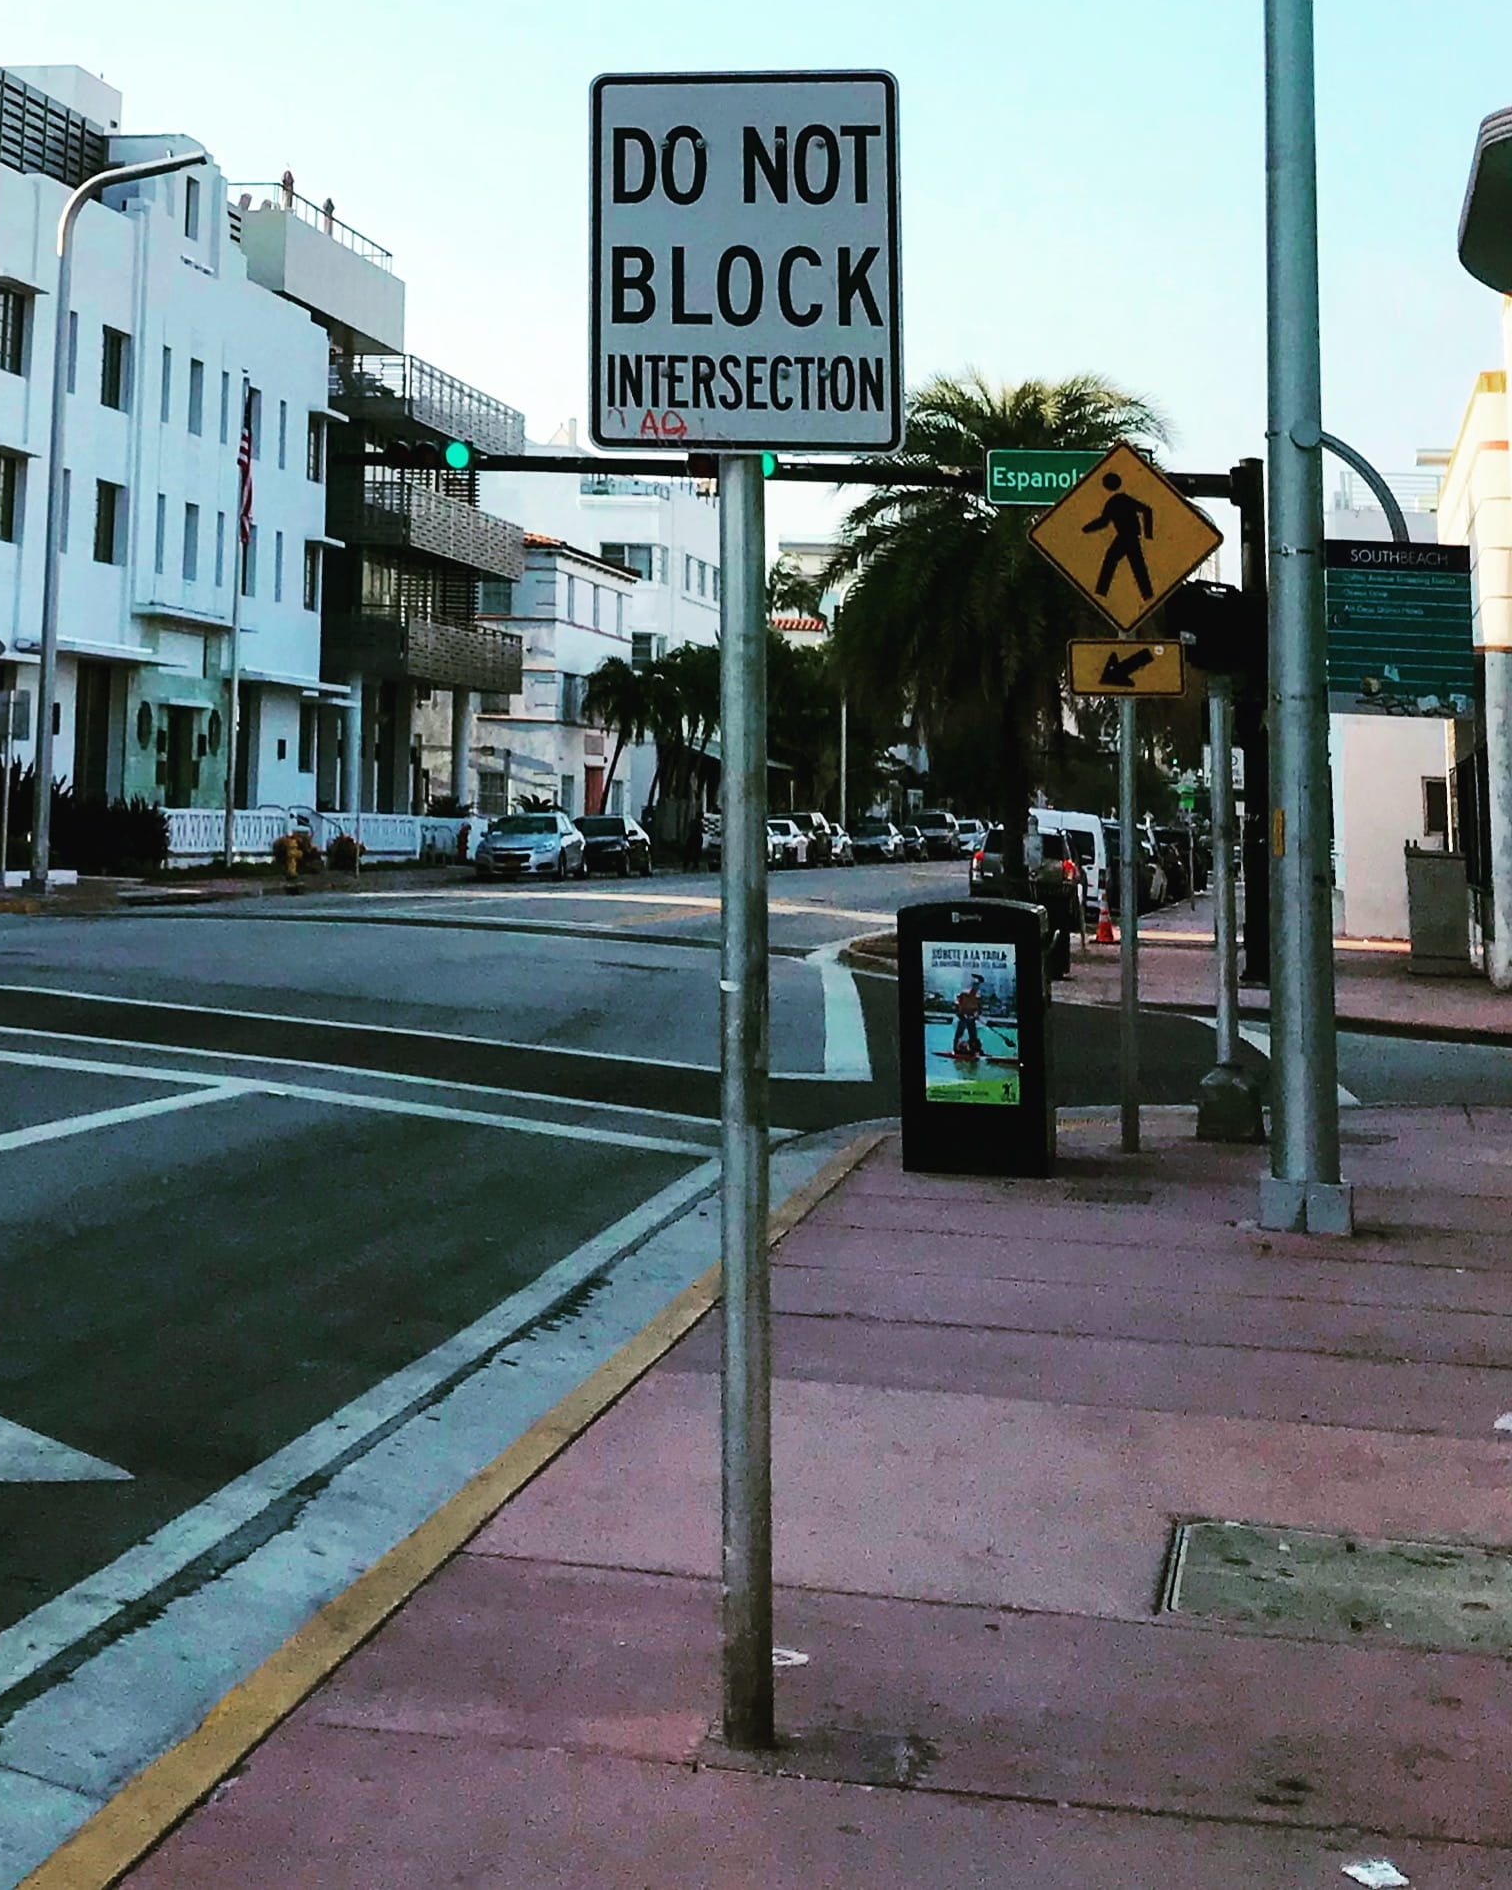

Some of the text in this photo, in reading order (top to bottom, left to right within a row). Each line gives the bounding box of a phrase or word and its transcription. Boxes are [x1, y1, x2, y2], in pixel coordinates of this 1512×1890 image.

[612, 124, 881, 205] DO NOT
[611, 245, 884, 327] BLOCK
[607, 354, 884, 412] INTERSECTION
